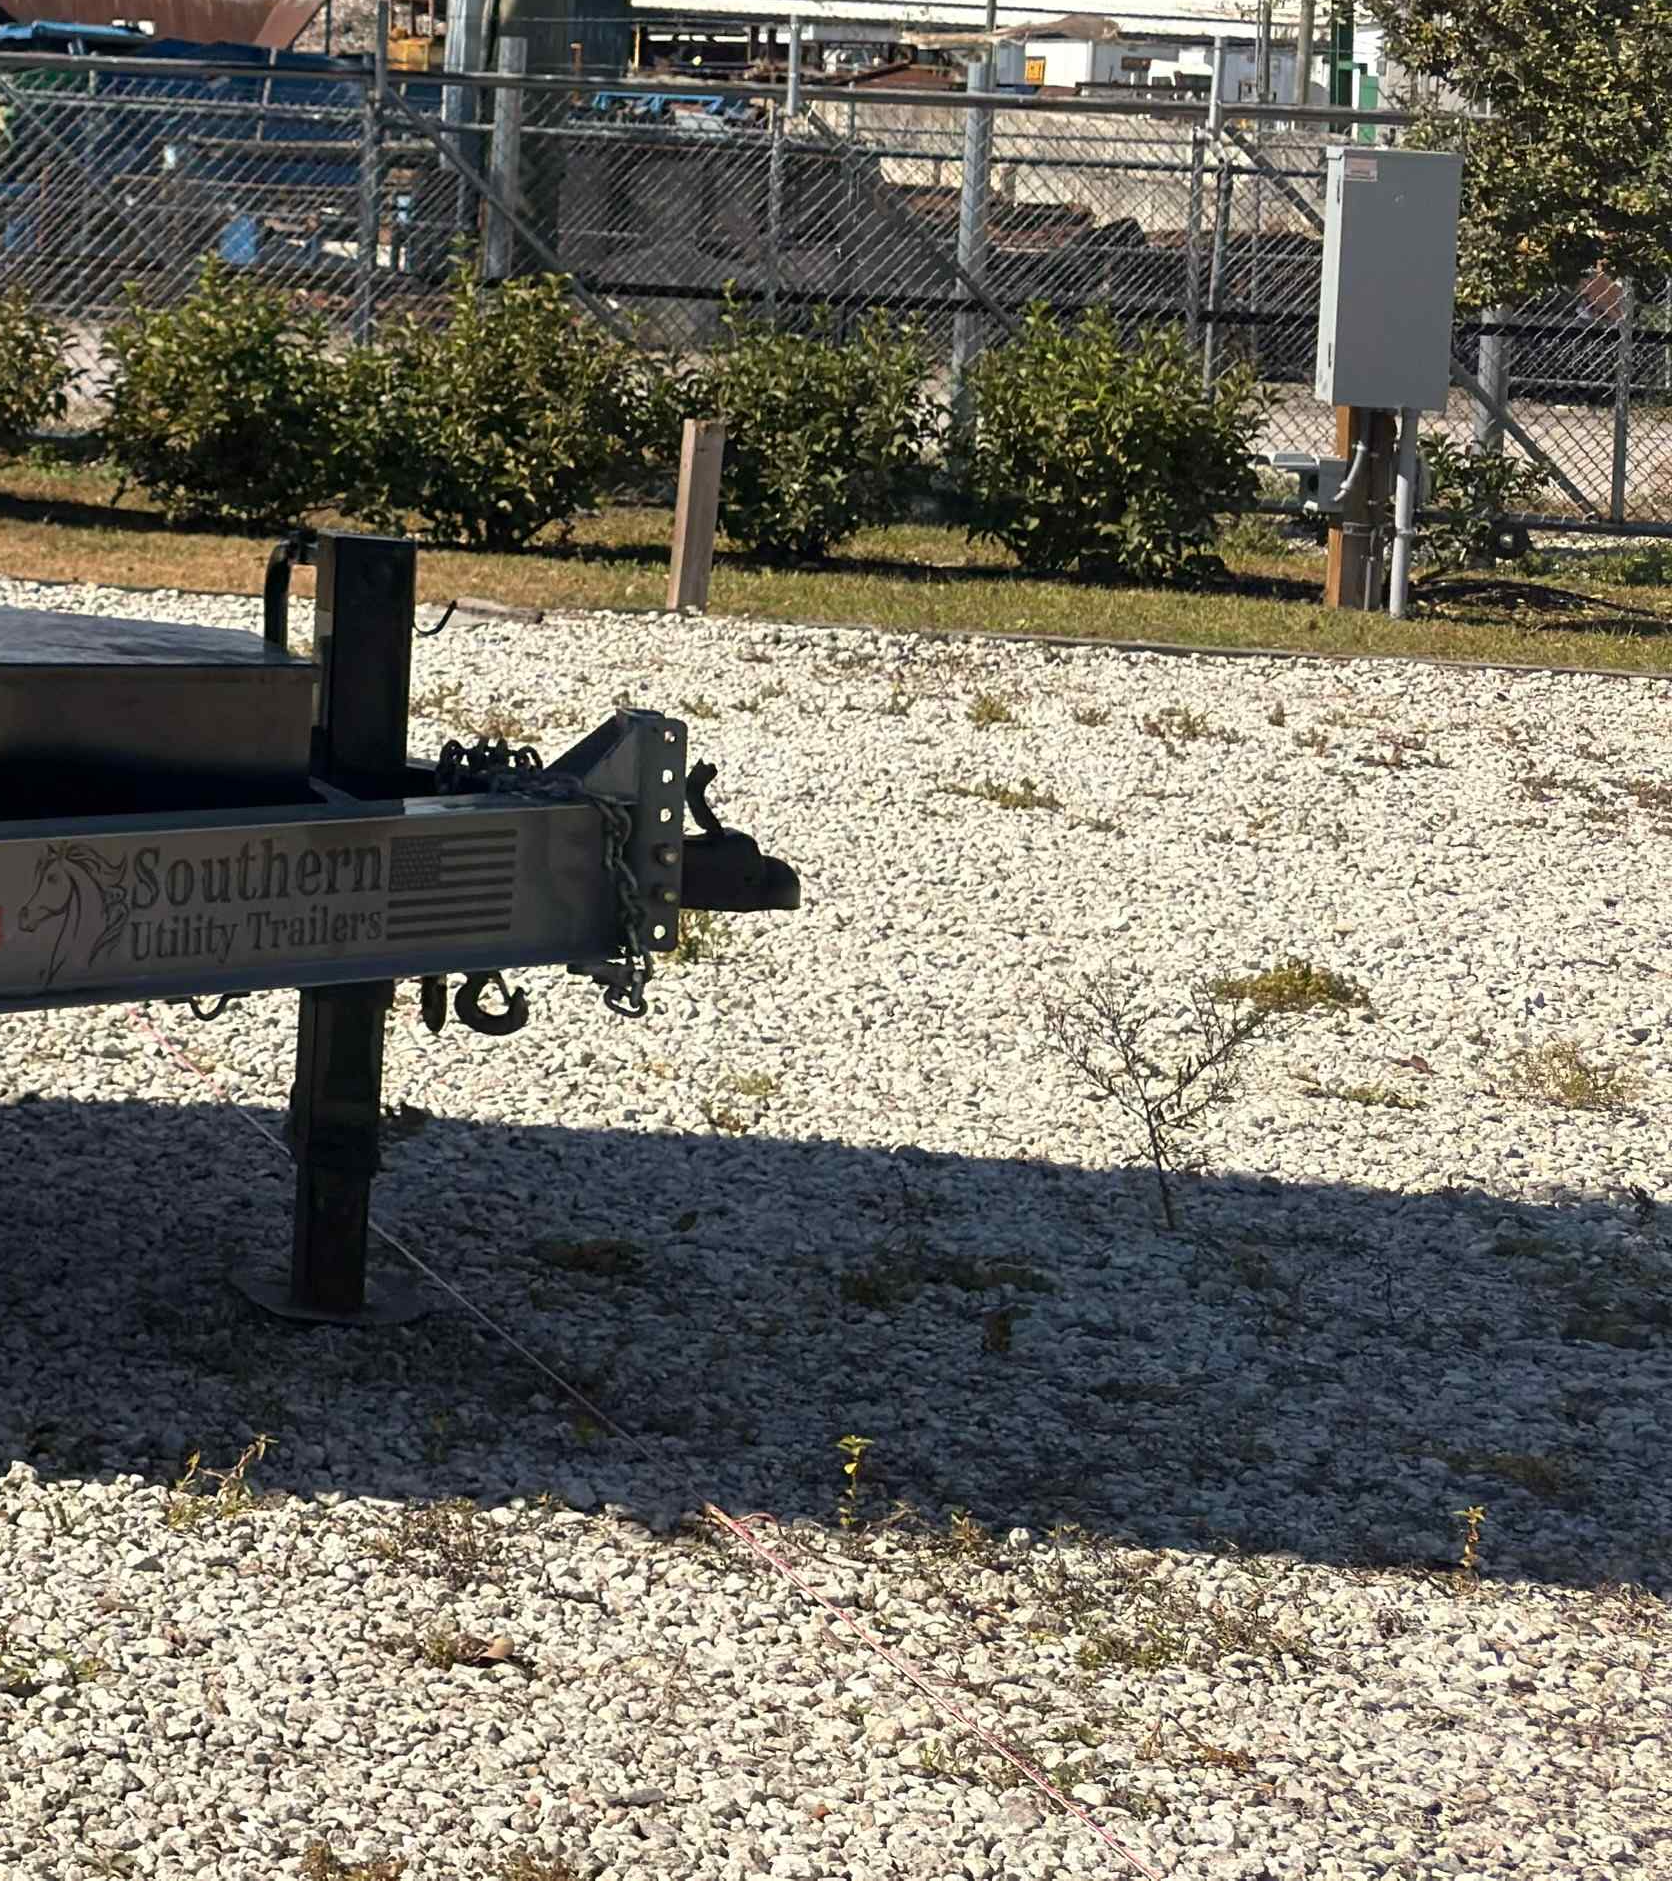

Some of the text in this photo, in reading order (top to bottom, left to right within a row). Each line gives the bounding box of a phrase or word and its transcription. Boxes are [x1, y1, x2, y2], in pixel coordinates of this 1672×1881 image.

[132, 837, 382, 909] Southern
[132, 905, 383, 964] Utility Trailers
